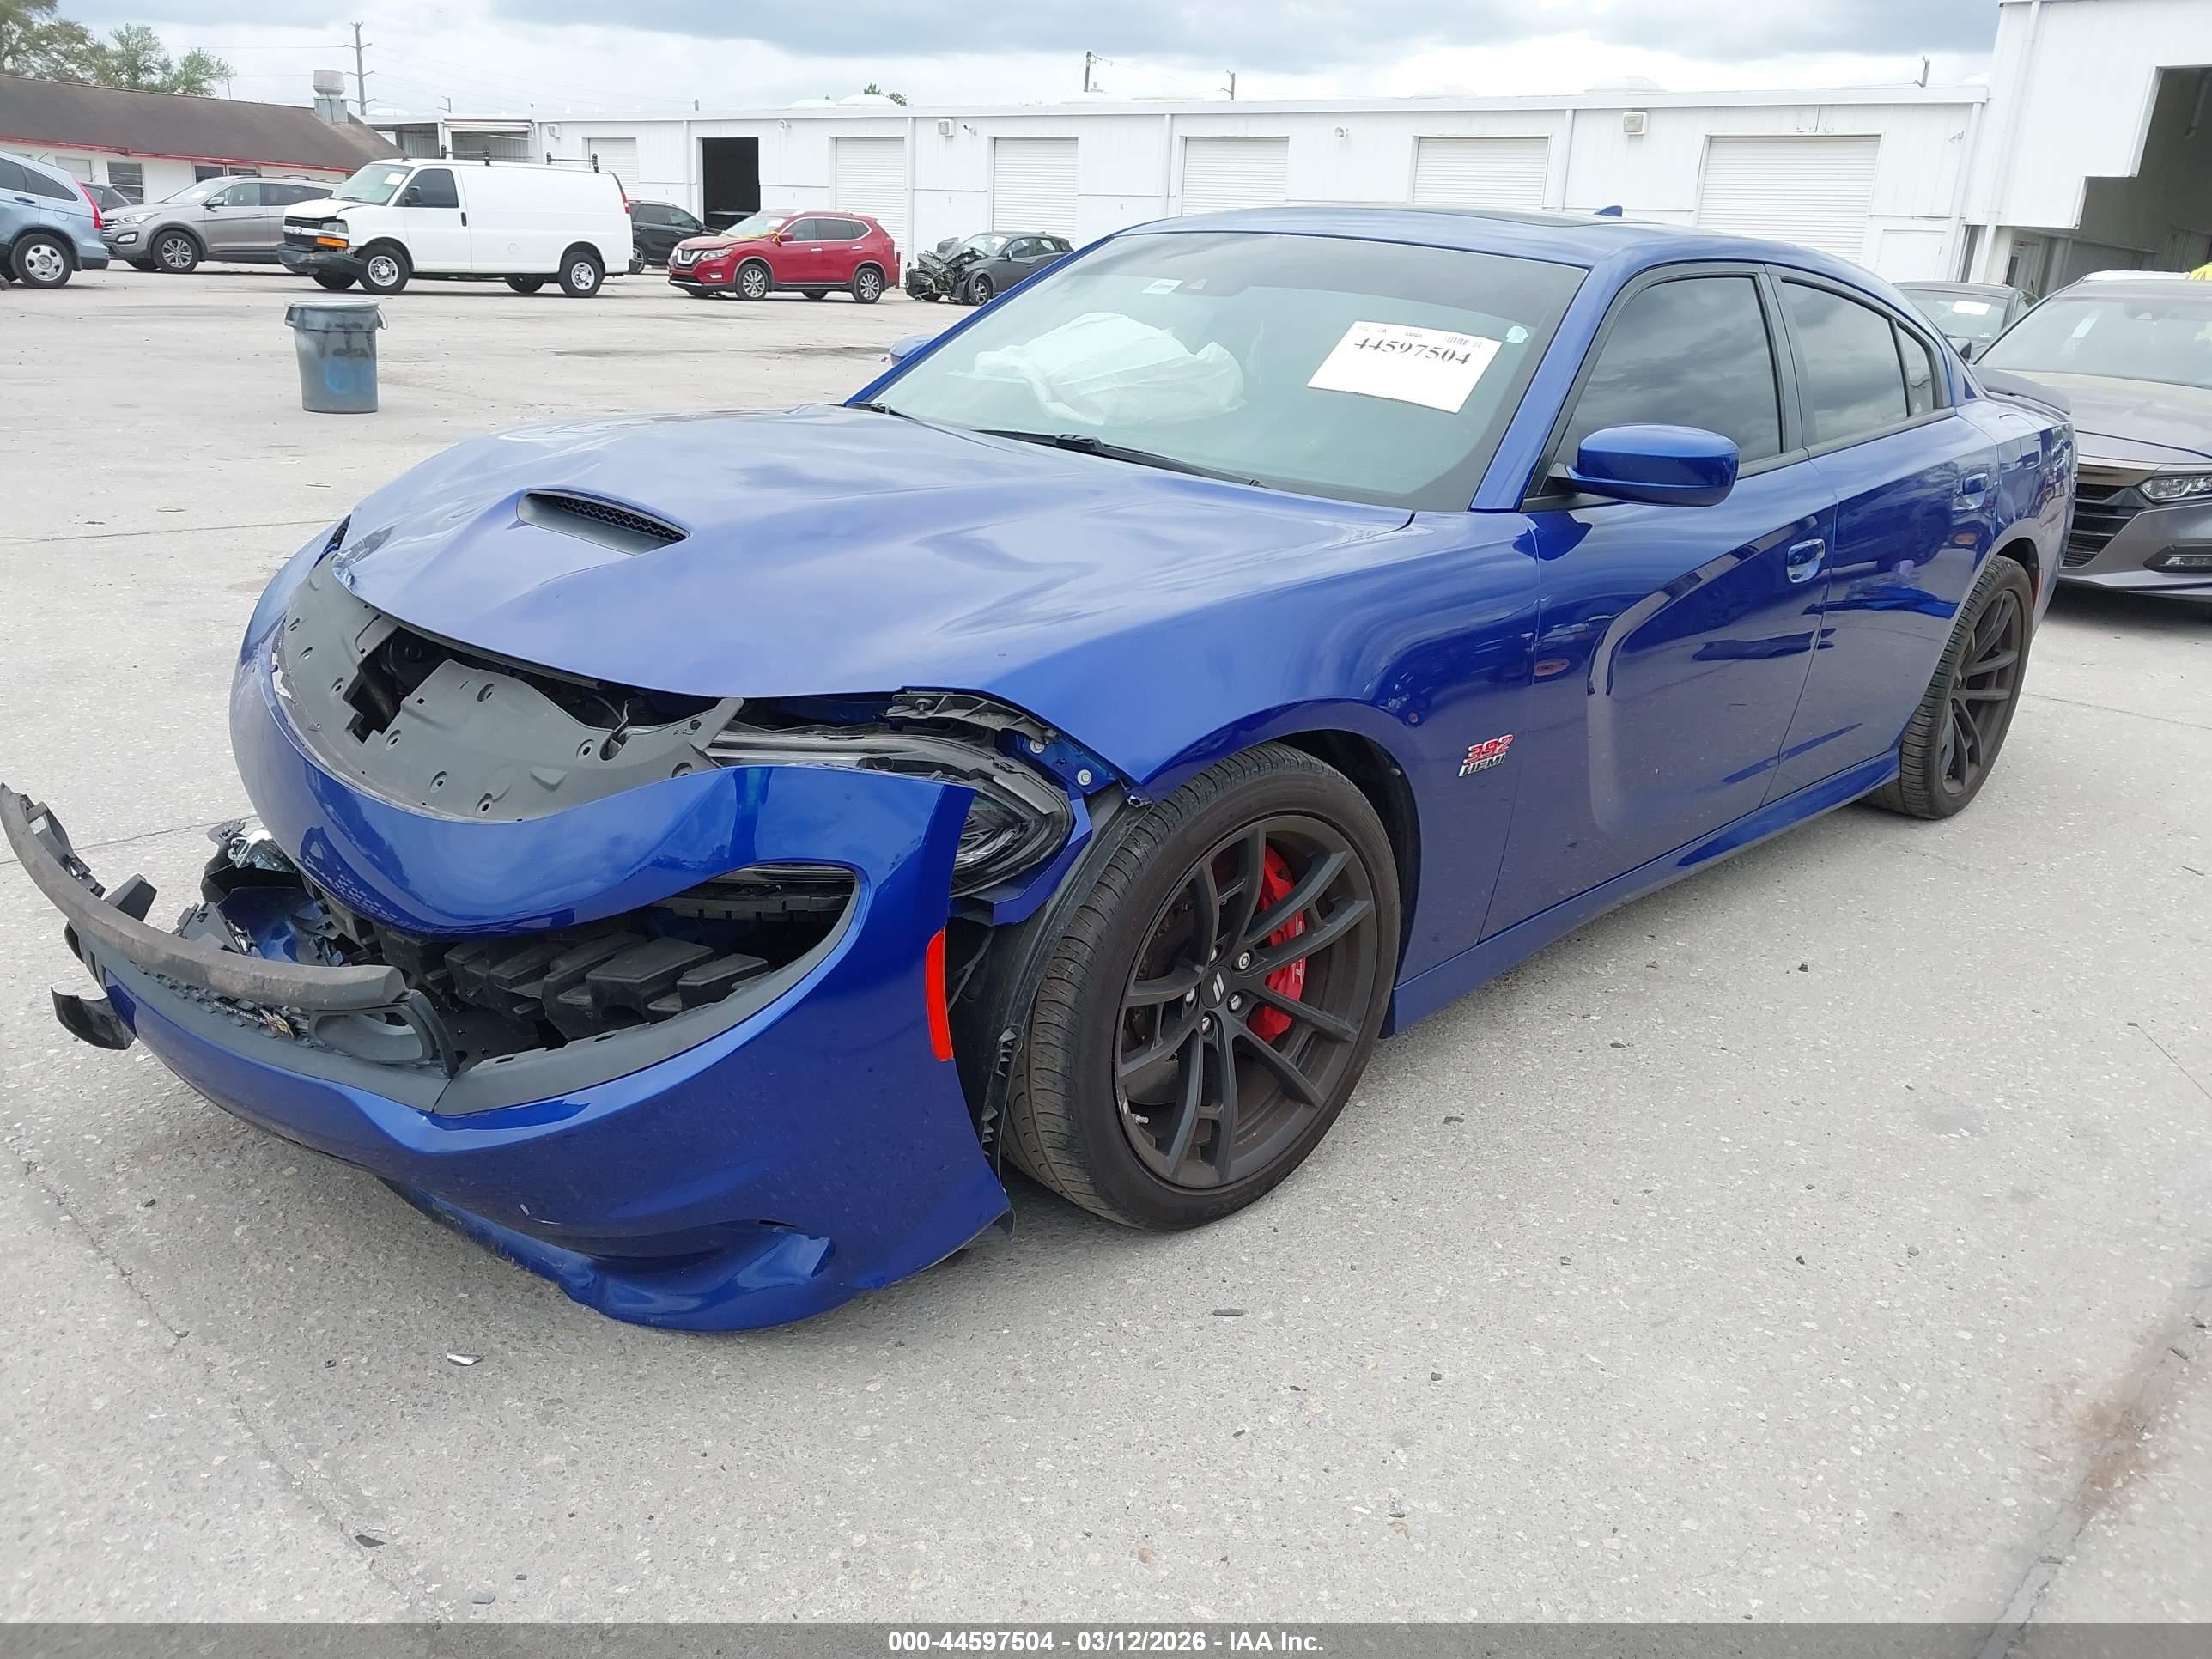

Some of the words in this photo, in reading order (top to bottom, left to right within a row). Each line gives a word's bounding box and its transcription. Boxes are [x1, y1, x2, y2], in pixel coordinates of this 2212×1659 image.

[1354, 337, 1472, 365] 44597504
[1462, 733, 1514, 764] 392
[1458, 752, 1506, 777] HEMI
